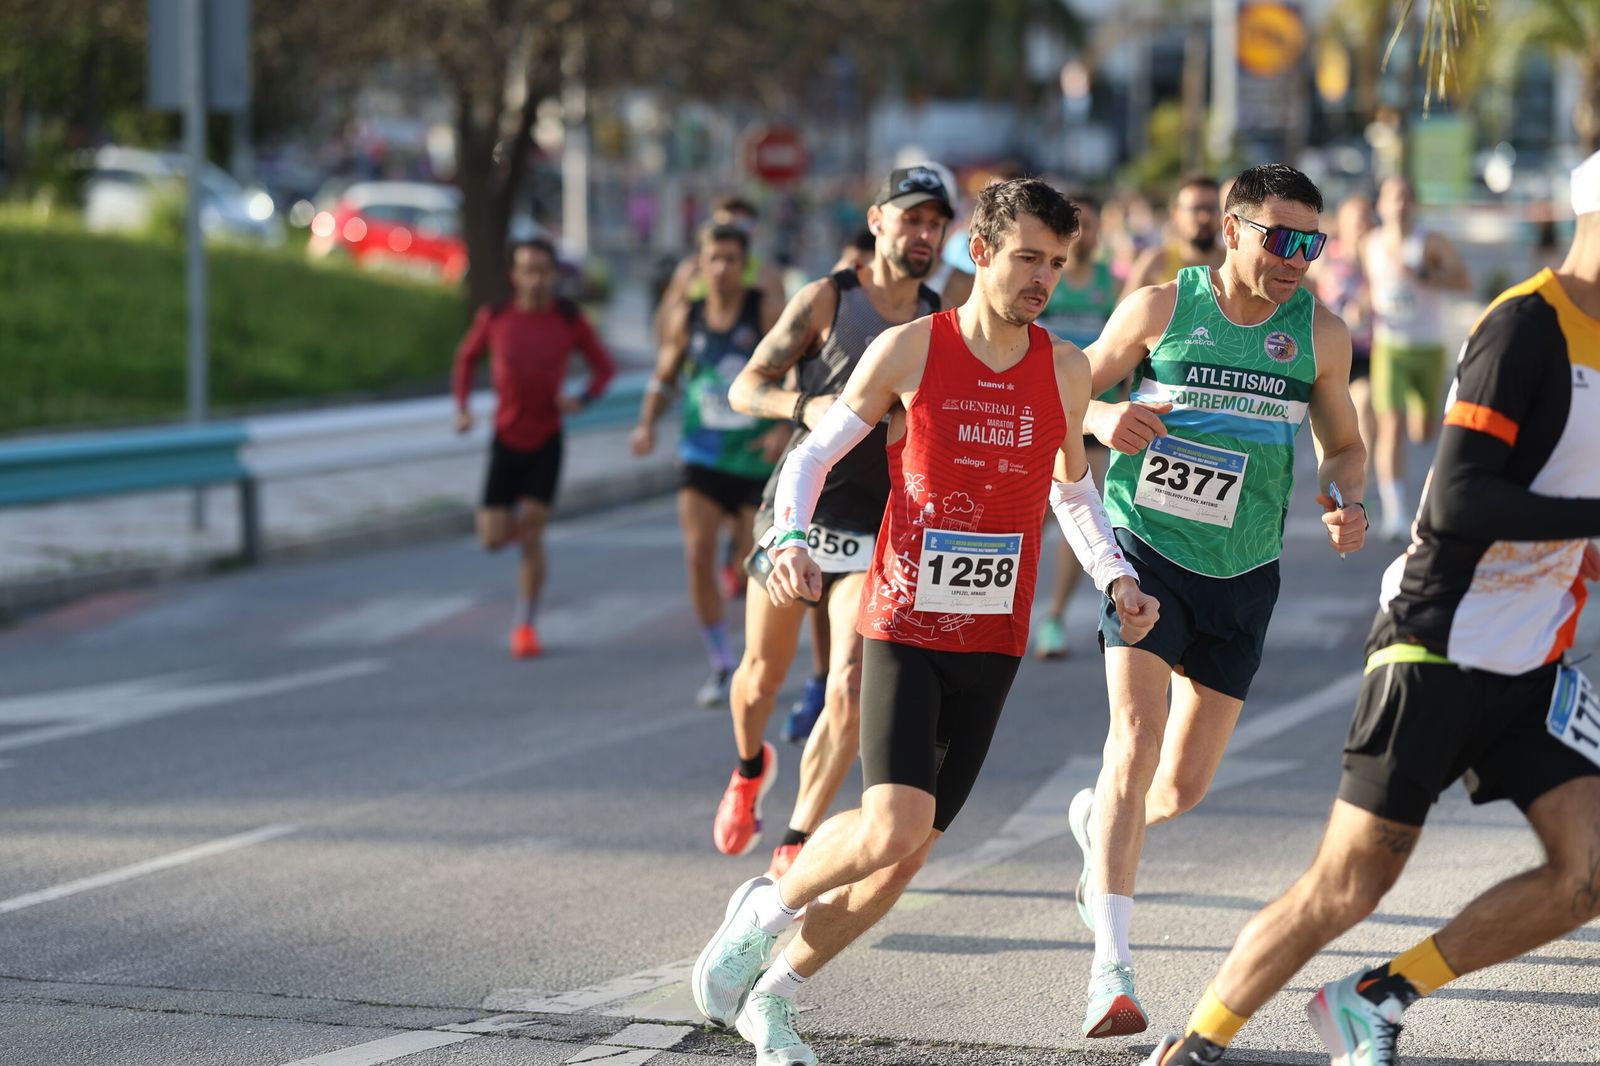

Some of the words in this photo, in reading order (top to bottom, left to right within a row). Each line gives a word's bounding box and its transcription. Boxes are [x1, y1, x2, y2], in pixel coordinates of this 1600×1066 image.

[977, 379, 1005, 390] luanvi
[1186, 366, 1287, 396] ATLETISMO
[960, 400, 1015, 416] GENERALI
[958, 422, 1015, 447] MÁLAGA
[1145, 455, 1238, 501] 2377
[807, 528, 859, 556] 650
[928, 554, 1014, 588] 1258
